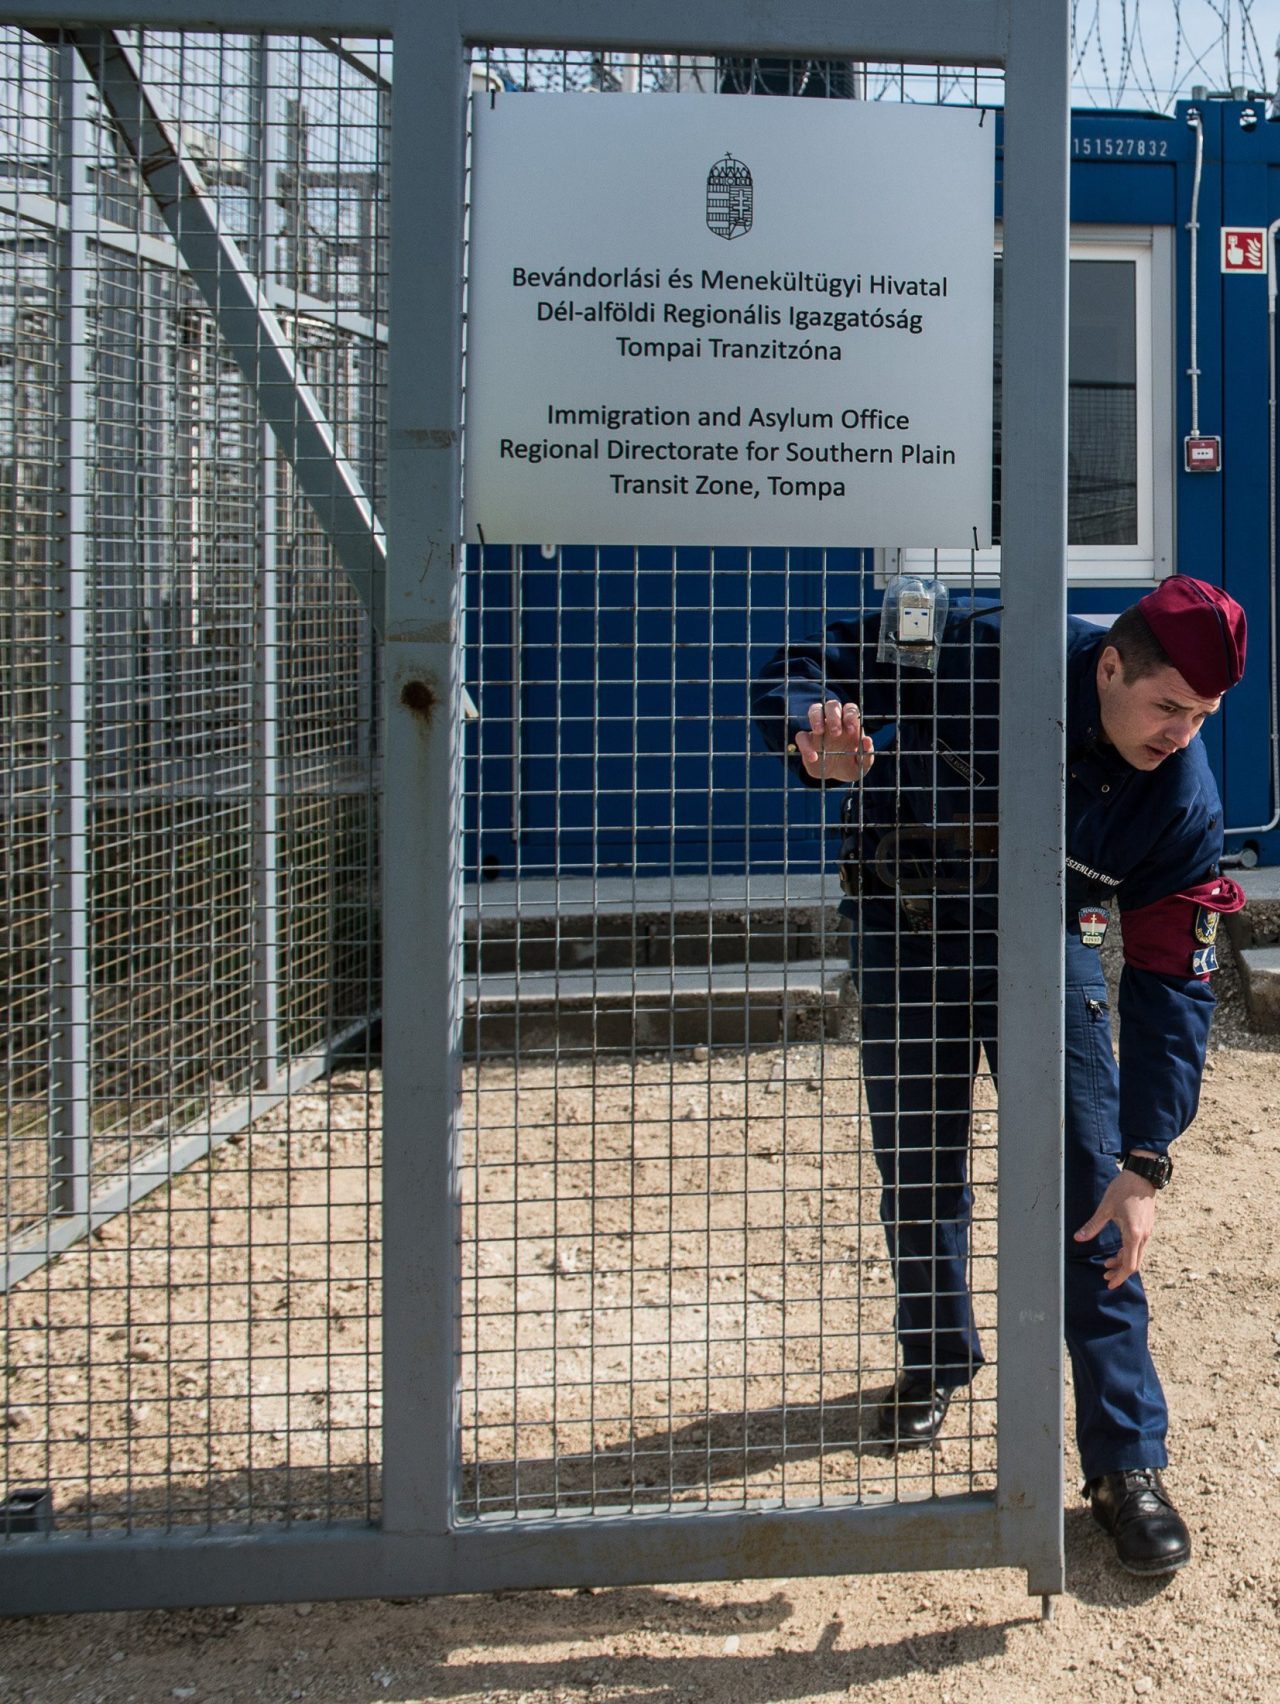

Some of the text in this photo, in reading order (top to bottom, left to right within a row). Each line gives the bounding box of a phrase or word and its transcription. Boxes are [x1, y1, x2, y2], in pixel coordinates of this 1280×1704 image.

[1073, 138, 1168, 156] 151527832
[512, 265, 948, 298] Bevándorlási és Menekültügyi Hivatal
[537, 300, 923, 334] Dél-alföldi Regionális Igazgatóság
[615, 336, 842, 362] Tompai Tranzitzóna
[547, 404, 910, 432] Immigration and Asylum Office
[500, 438, 956, 465] Regional Directorate for Southern Plain
[609, 473, 846, 501] Transit Zone, Tompa
